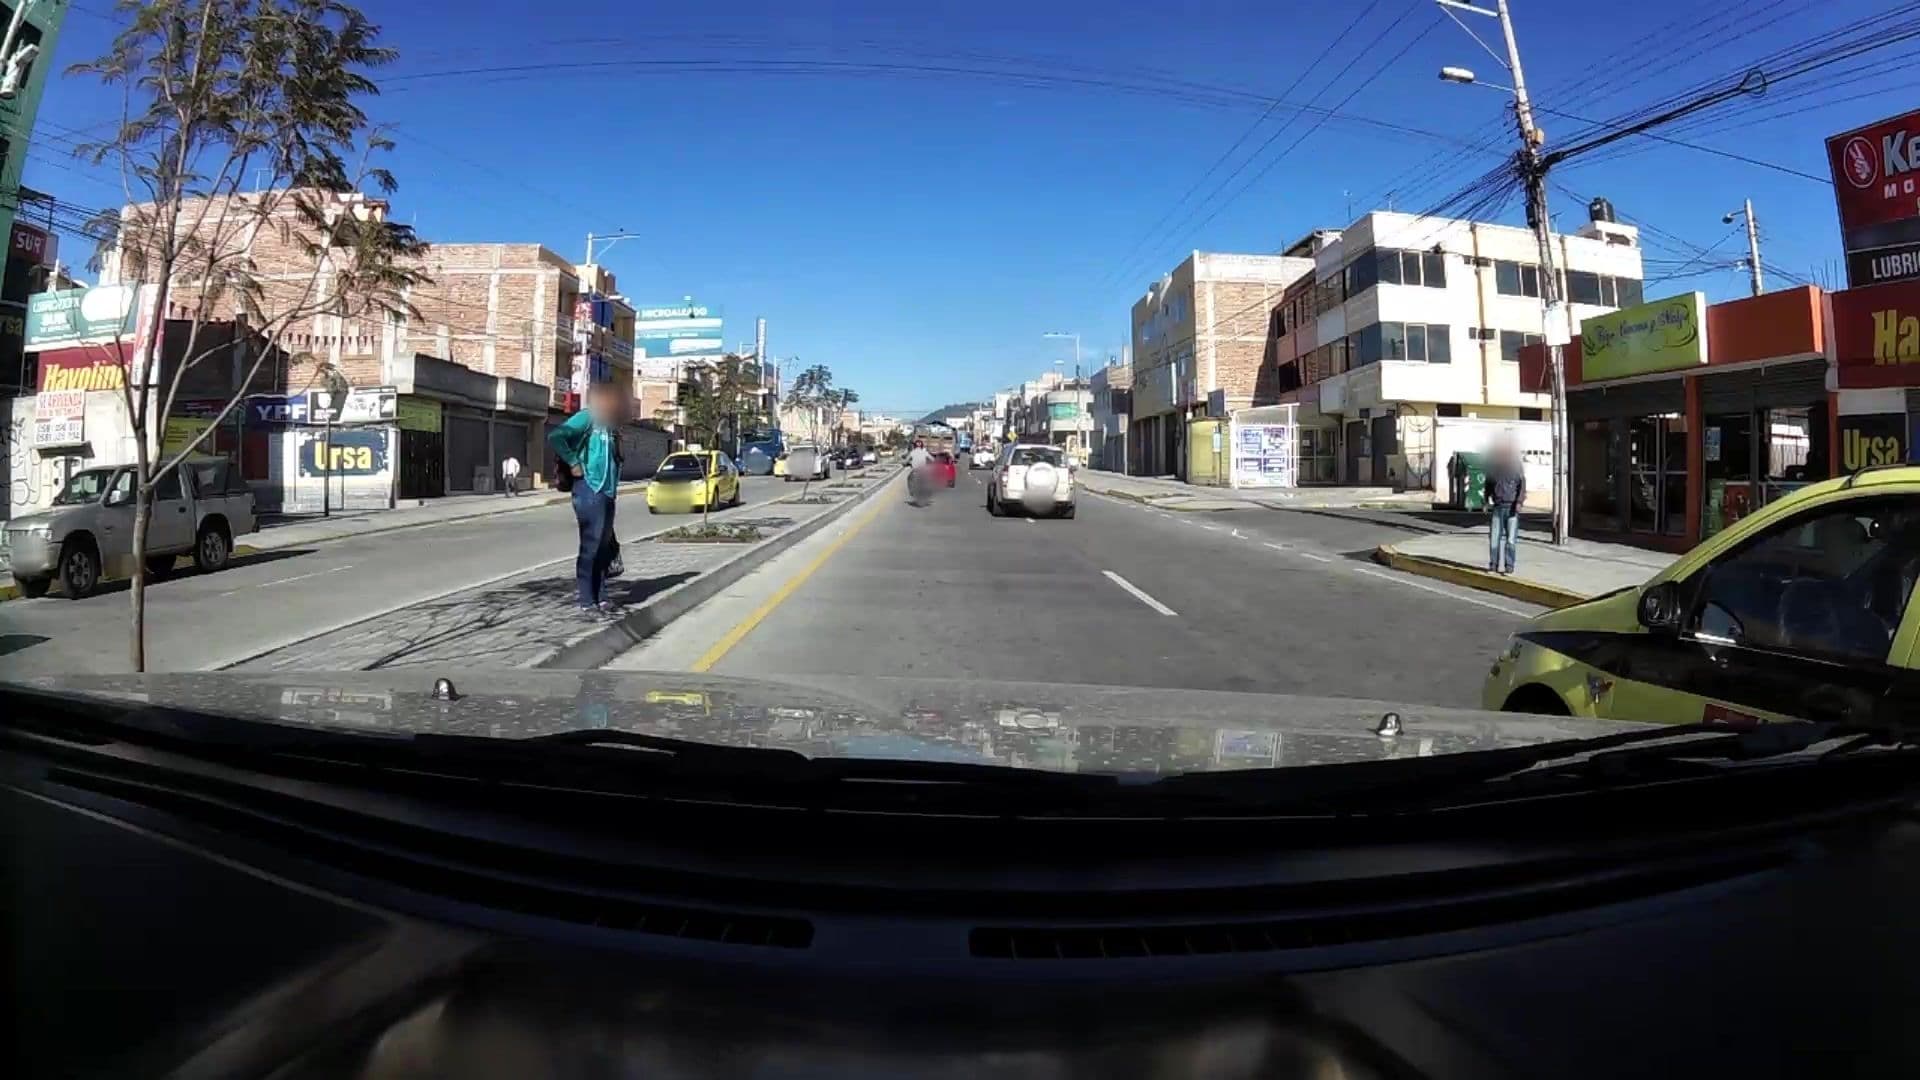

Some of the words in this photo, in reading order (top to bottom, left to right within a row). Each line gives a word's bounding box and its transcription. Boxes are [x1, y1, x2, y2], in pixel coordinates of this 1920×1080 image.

[15, 231, 42, 254] SUR
[1871, 250, 1920, 279] LUBRI
[1871, 309, 1920, 366] Ha
[256, 404, 308, 421] YPF
[314, 440, 373, 470] Ursa
[1843, 428, 1900, 471] Ursa
